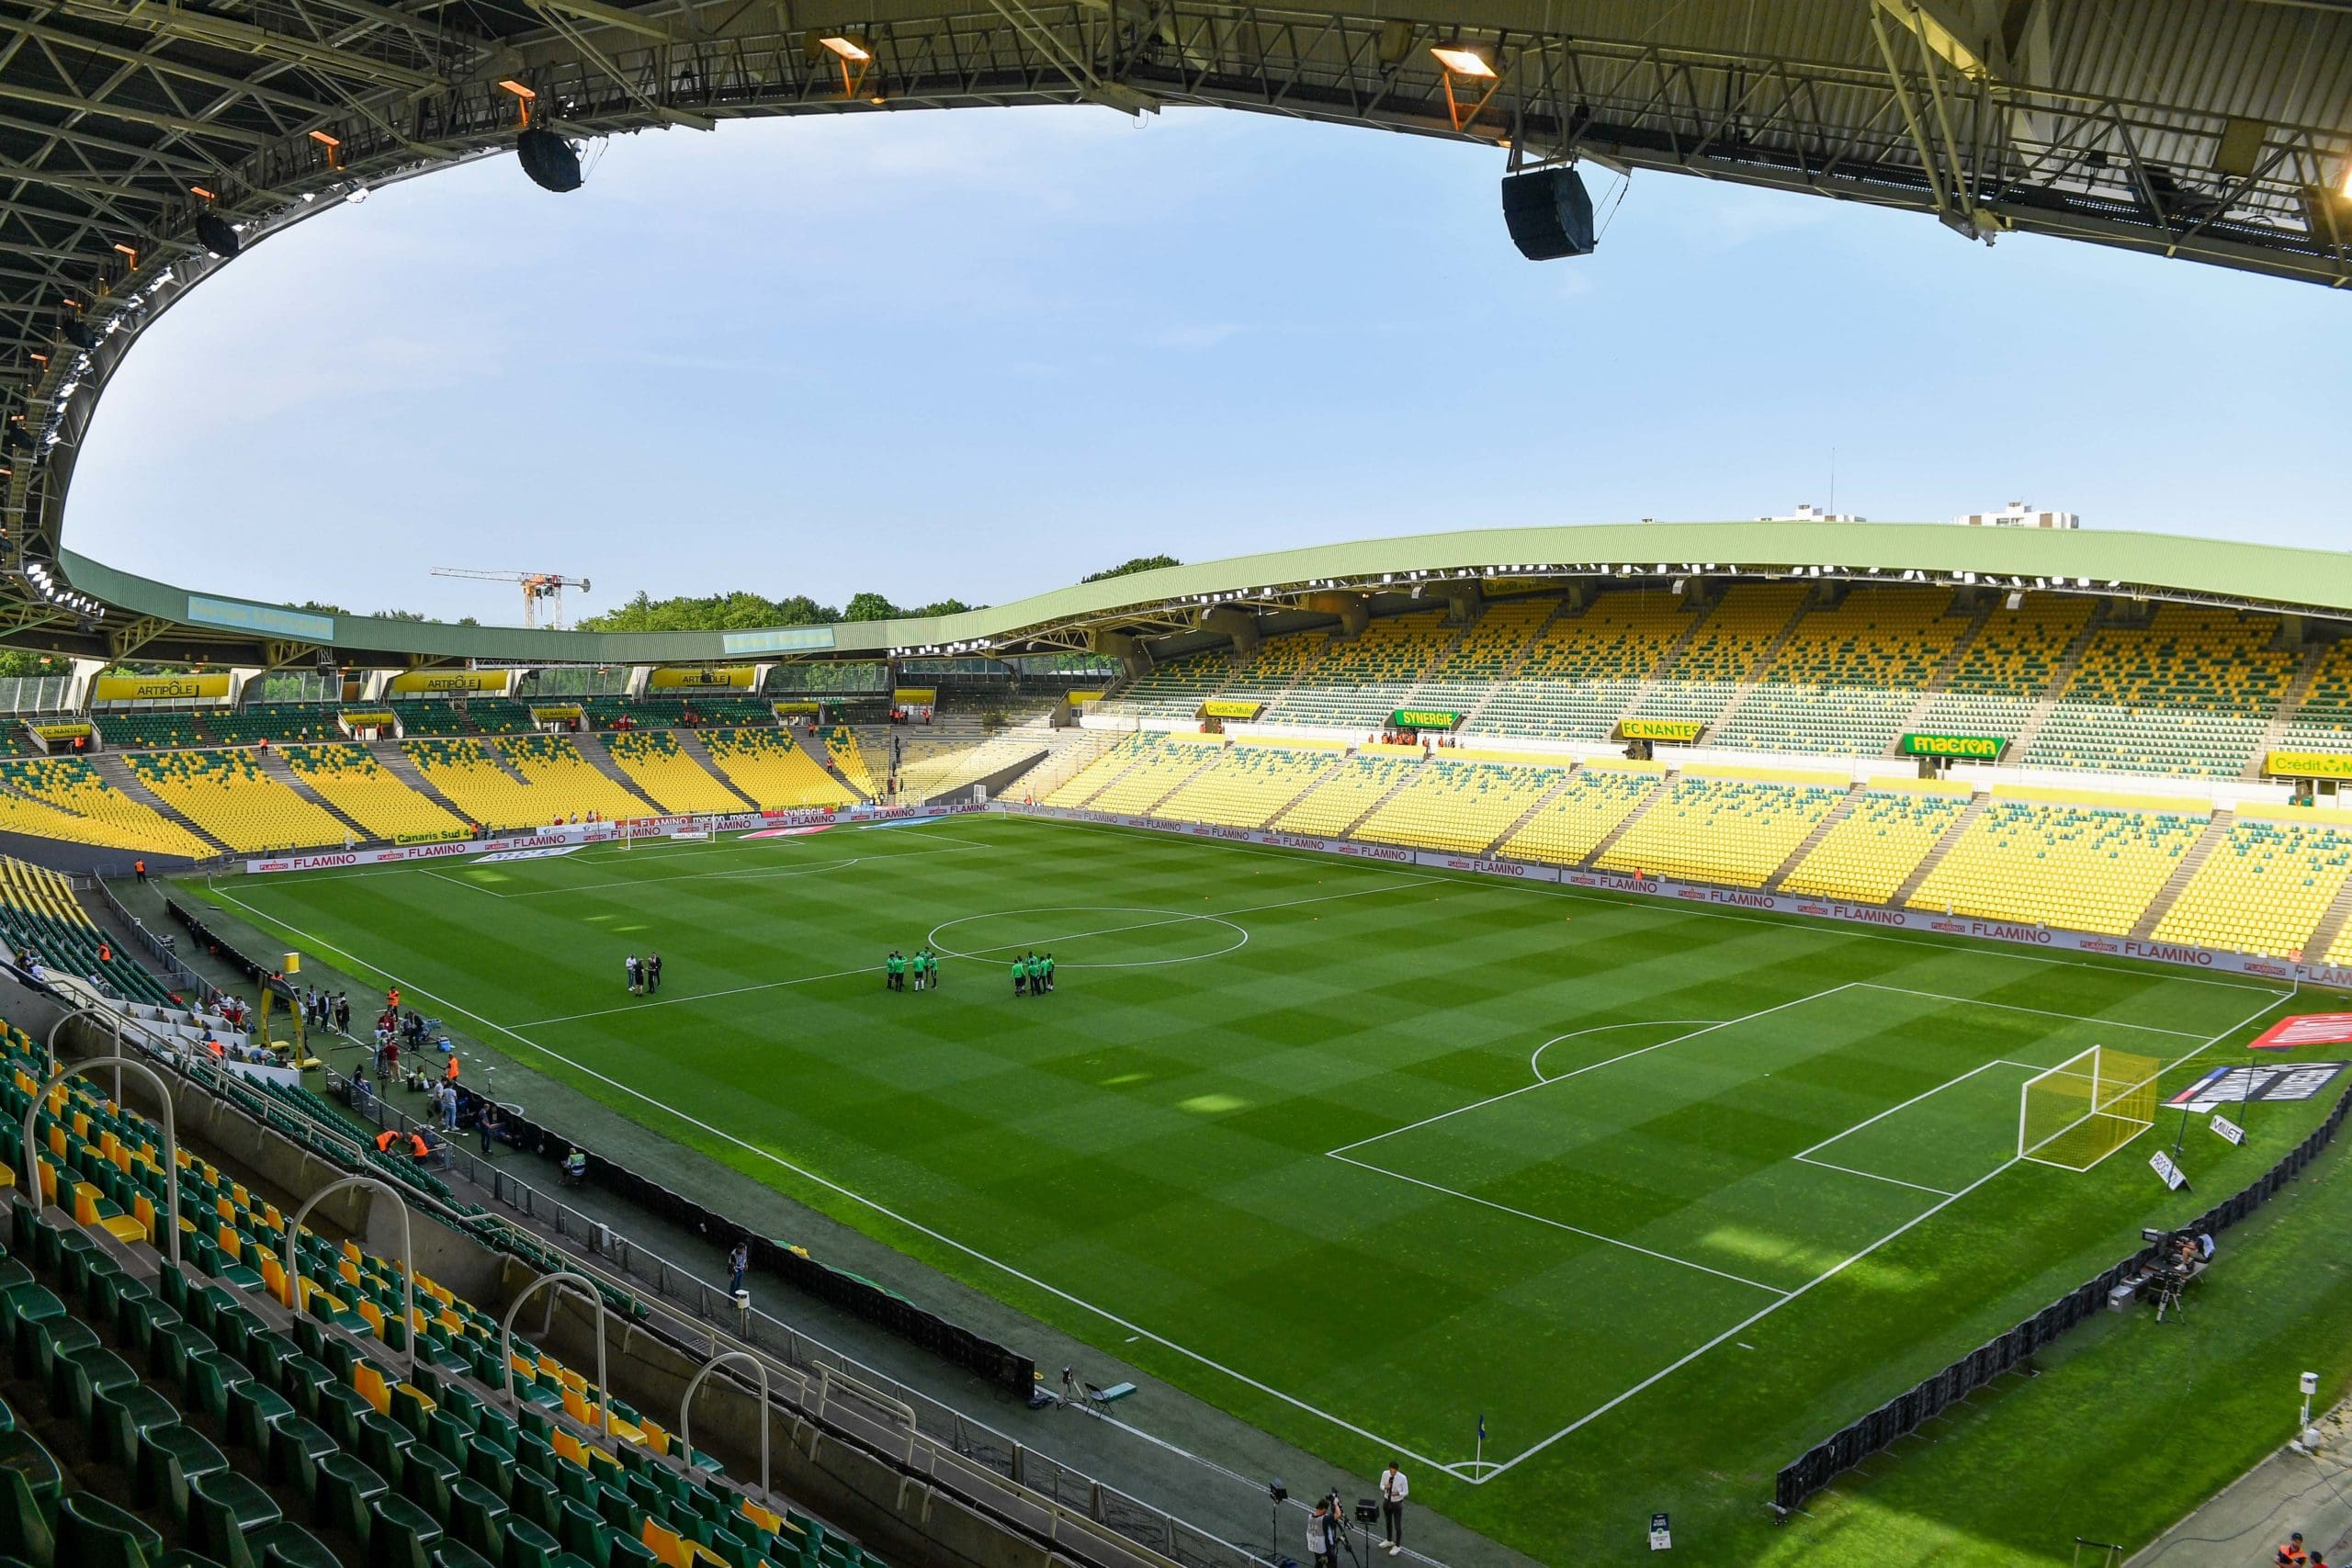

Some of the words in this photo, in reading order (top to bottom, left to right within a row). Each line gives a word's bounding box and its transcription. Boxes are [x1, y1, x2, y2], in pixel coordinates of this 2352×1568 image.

[427, 675, 476, 688] ARTIPÔLE
[137, 681, 193, 696] ARTIPÔLE
[1403, 711, 1453, 726] SYNERGIE
[53, 727, 83, 735] NANTES
[1623, 722, 1640, 734] FC
[1914, 737, 1996, 754] macron
[874, 808, 915, 818] FLAMINO
[950, 804, 990, 814] FLAMINO
[1023, 806, 1055, 817] FLAMINO
[791, 814, 836, 825] FLAMINO
[1083, 812, 1118, 824] FLAMINO
[703, 820, 752, 830] FLAMINO
[1147, 819, 1182, 832] FLAMINO
[397, 831, 438, 842] Canaris
[441, 829, 460, 839] Sud
[463, 829, 473, 838] 4
[611, 827, 661, 839] FLAMINO
[1212, 828, 1250, 840] FLAMINO
[514, 835, 566, 847] FLAMINO
[1283, 837, 1325, 851] FLAMINO
[408, 844, 466, 858] FLAMINO
[1361, 846, 1407, 861] FLAMINO
[294, 853, 356, 869] FLAMINO
[1474, 861, 1524, 875] FLAMINO
[1600, 876, 1657, 893] FLAMINO
[1711, 891, 1774, 908] FLAMINO
[1834, 906, 1905, 925] FLAMINO
[1931, 921, 1965, 932] FLAMINO
[1973, 923, 2052, 943] FLAMINO
[2080, 940, 2118, 952] FLAMINO
[2124, 942, 2212, 965] FLAMINO
